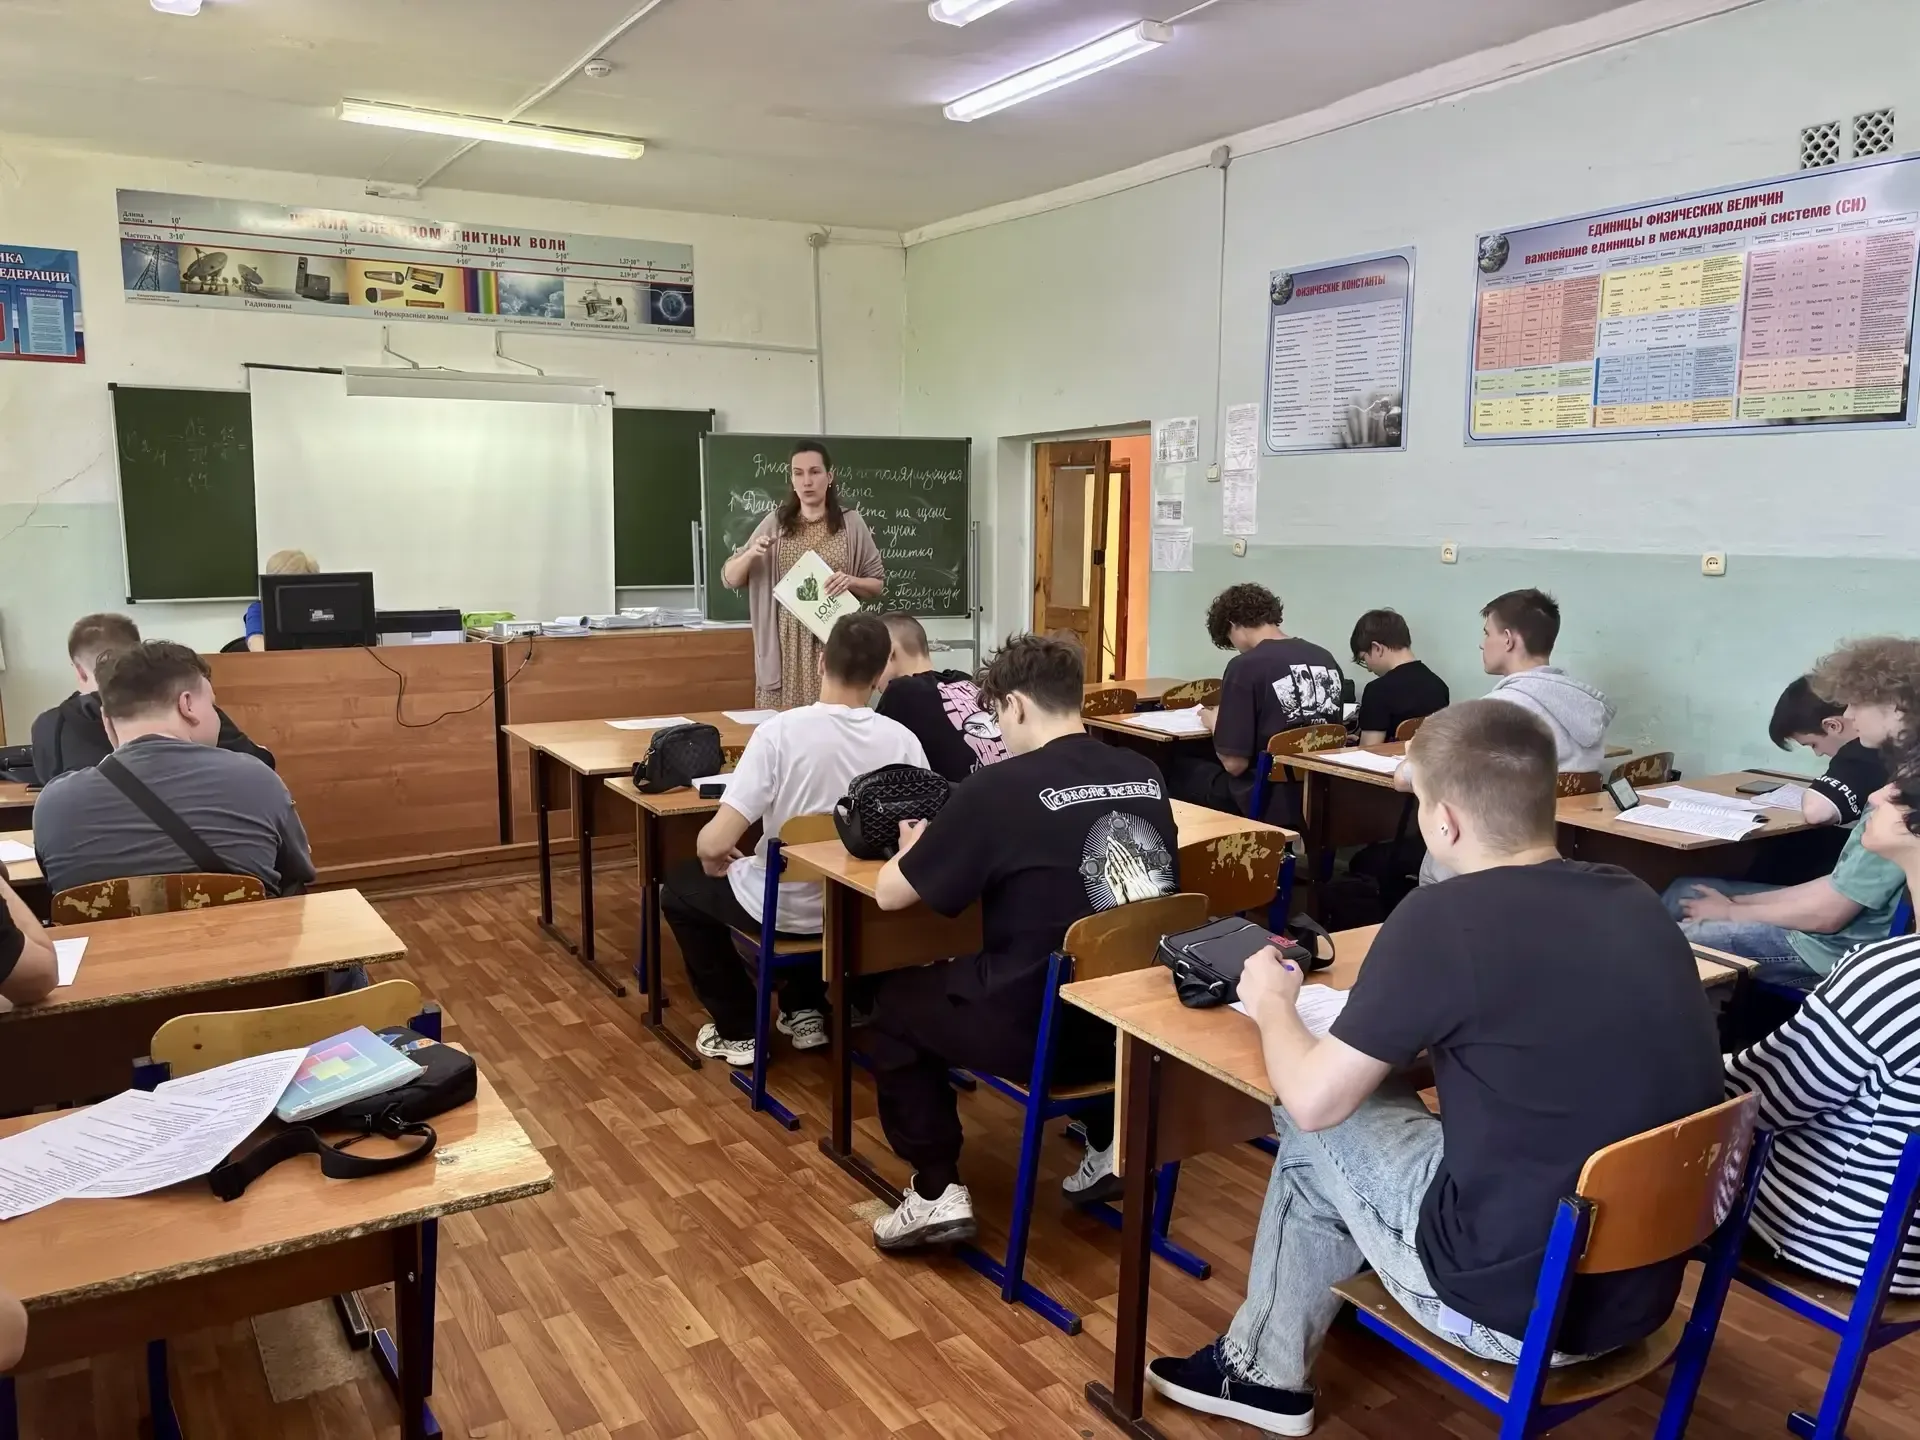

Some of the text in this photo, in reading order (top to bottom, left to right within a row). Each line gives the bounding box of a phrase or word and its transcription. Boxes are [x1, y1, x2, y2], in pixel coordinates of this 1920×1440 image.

[1588, 190, 1784, 237] ЕДИНИЦЫ ФИЗИЧЕСКИХ ВЕЛИЧИН
[1524, 245, 1588, 265] важнейшие
[1591, 235, 1645, 255] единицы
[1648, 233, 1656, 244] в
[1659, 212, 1767, 242] международной
[1770, 204, 1832, 224] системе
[1835, 196, 1867, 216] (СИ)
[529, 237, 566, 251] ВОЛН
[1295, 275, 1386, 297] ФИЗИЧЕСКИЕ КОНСТАНТЫ
[244, 300, 292, 310] Радиоволны
[814, 595, 838, 619] LOVE
[821, 602, 843, 624] NATURE
